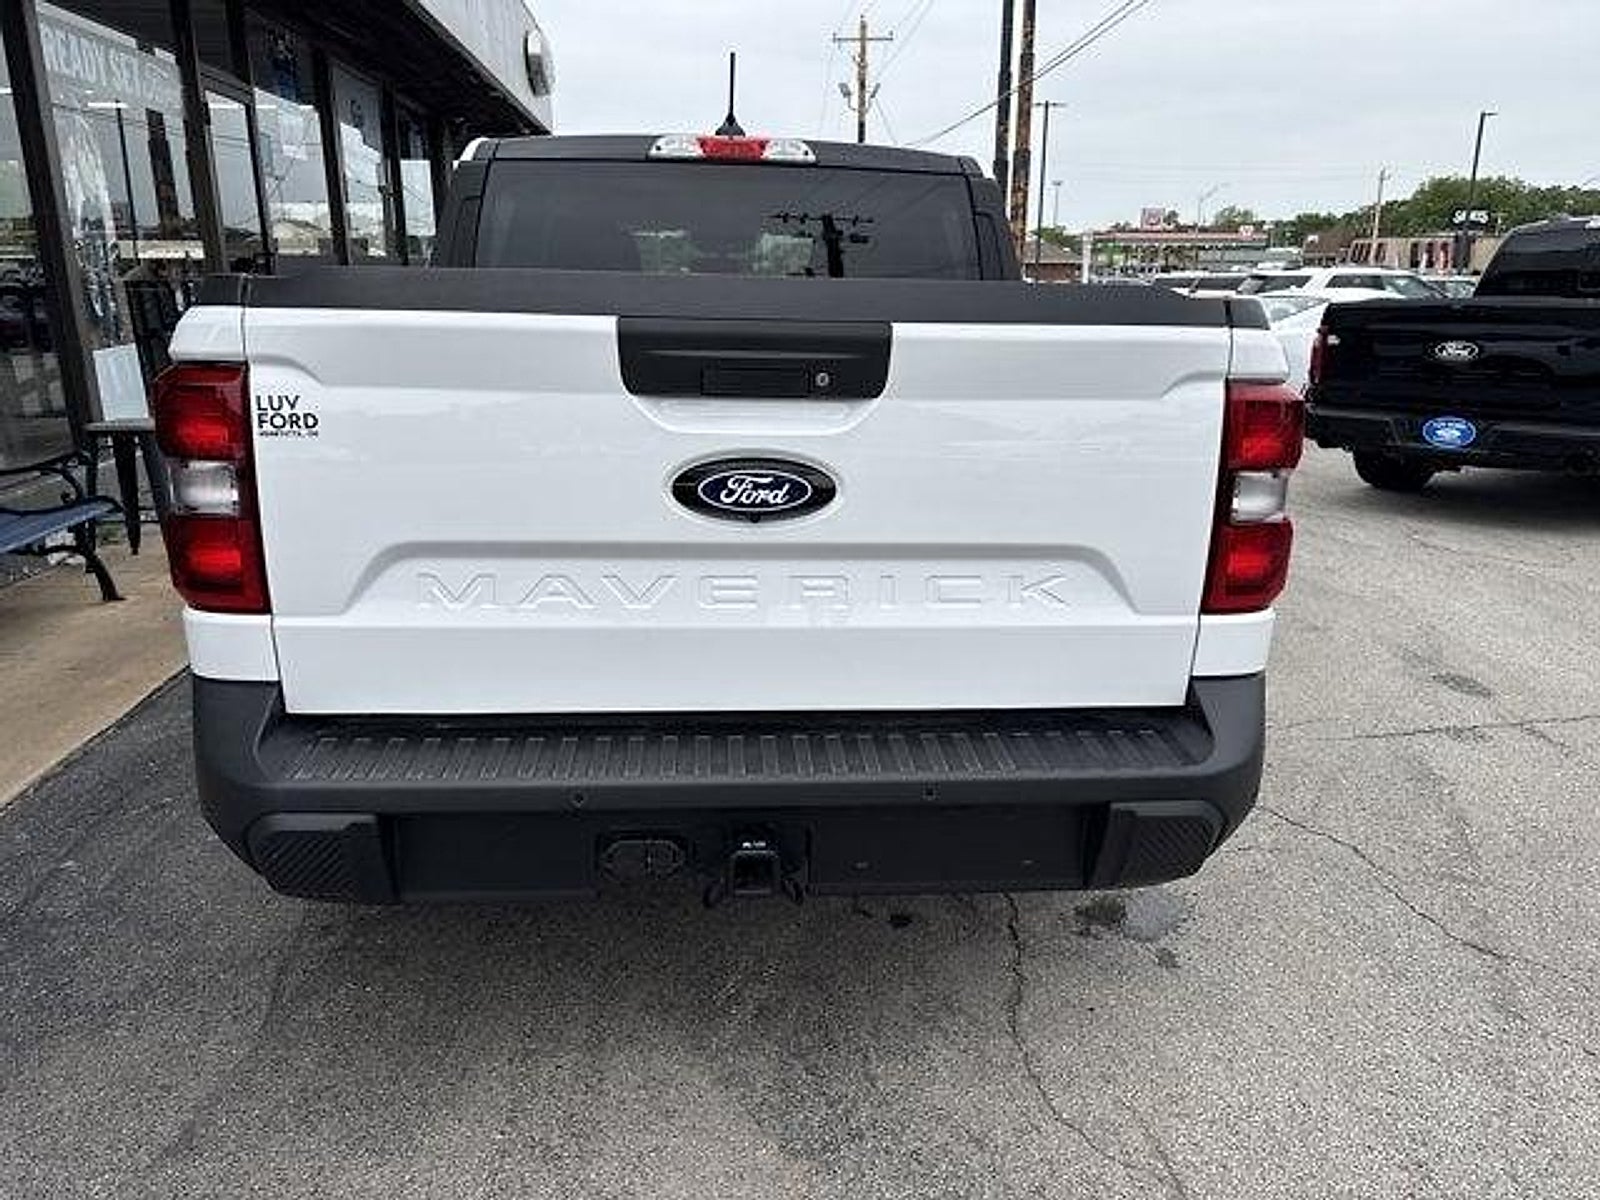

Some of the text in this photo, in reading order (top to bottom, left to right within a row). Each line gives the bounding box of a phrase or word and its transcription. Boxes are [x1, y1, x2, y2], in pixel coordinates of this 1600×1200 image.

[39, 21, 107, 87] READY
[257, 413, 319, 429] FORD
[720, 475, 791, 504] Ford
[416, 572, 1070, 610] MAVERICK
